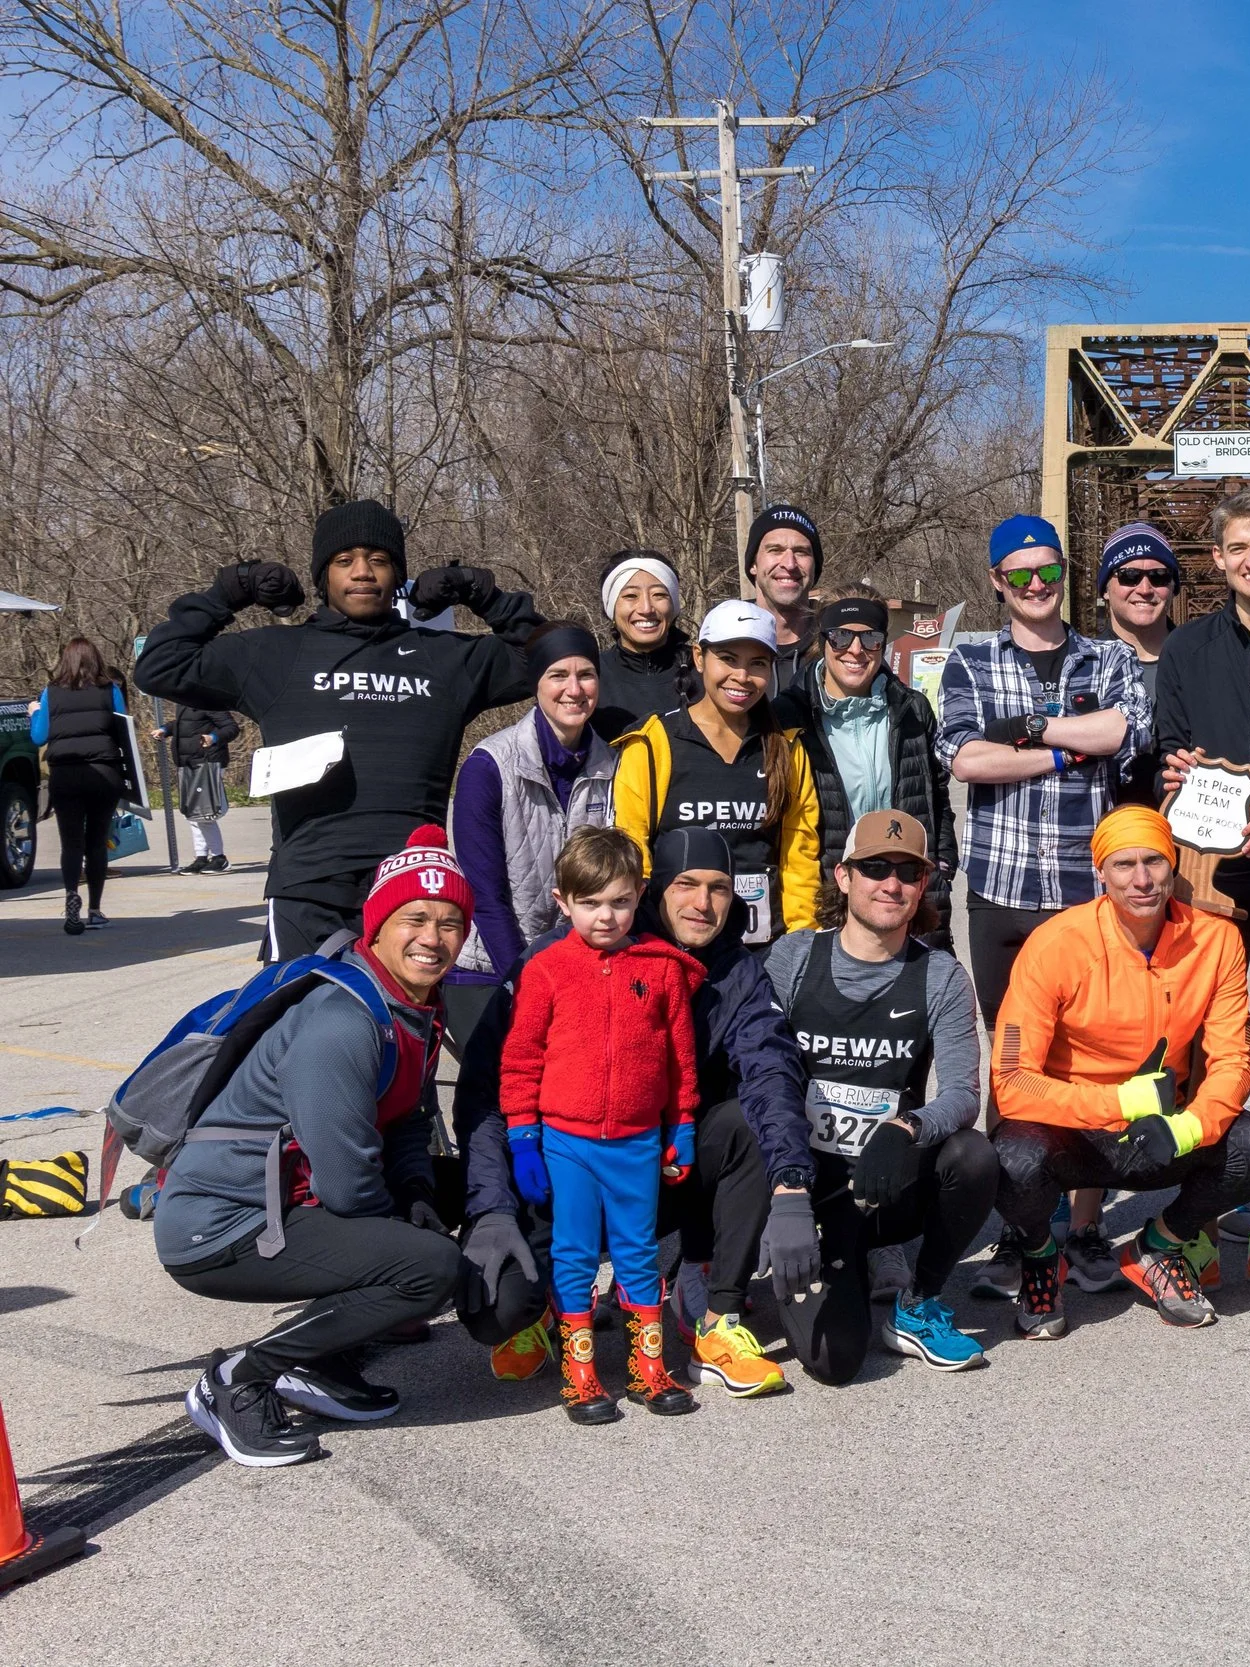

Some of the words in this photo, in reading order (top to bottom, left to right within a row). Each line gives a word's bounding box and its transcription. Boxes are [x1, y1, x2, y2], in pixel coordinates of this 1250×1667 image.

[1178, 437, 1201, 446] OLD
[1202, 436, 1235, 446] CHAIN
[916, 624, 935, 633] 66
[313, 672, 432, 697] SPEWAK
[357, 692, 396, 702] RACING
[1190, 775, 1207, 788] 1st
[1211, 780, 1242, 797] Place
[1197, 792, 1230, 810] TEAM
[678, 801, 769, 821] SPEWA
[1173, 808, 1199, 821] CHAIN
[1202, 815, 1213, 824] OF
[1215, 818, 1243, 831] ROCKS
[719, 822, 753, 830] RACING
[1197, 825, 1213, 839] 6K
[736, 876, 763, 889] IVER
[796, 1030, 915, 1059] SPEWAK
[834, 1058, 872, 1068] RACING
[815, 1082, 842, 1099] BIG
[845, 1087, 891, 1104] RIVER
[817, 1112, 880, 1147] 327
[200, 1373, 215, 1406] HOKA
